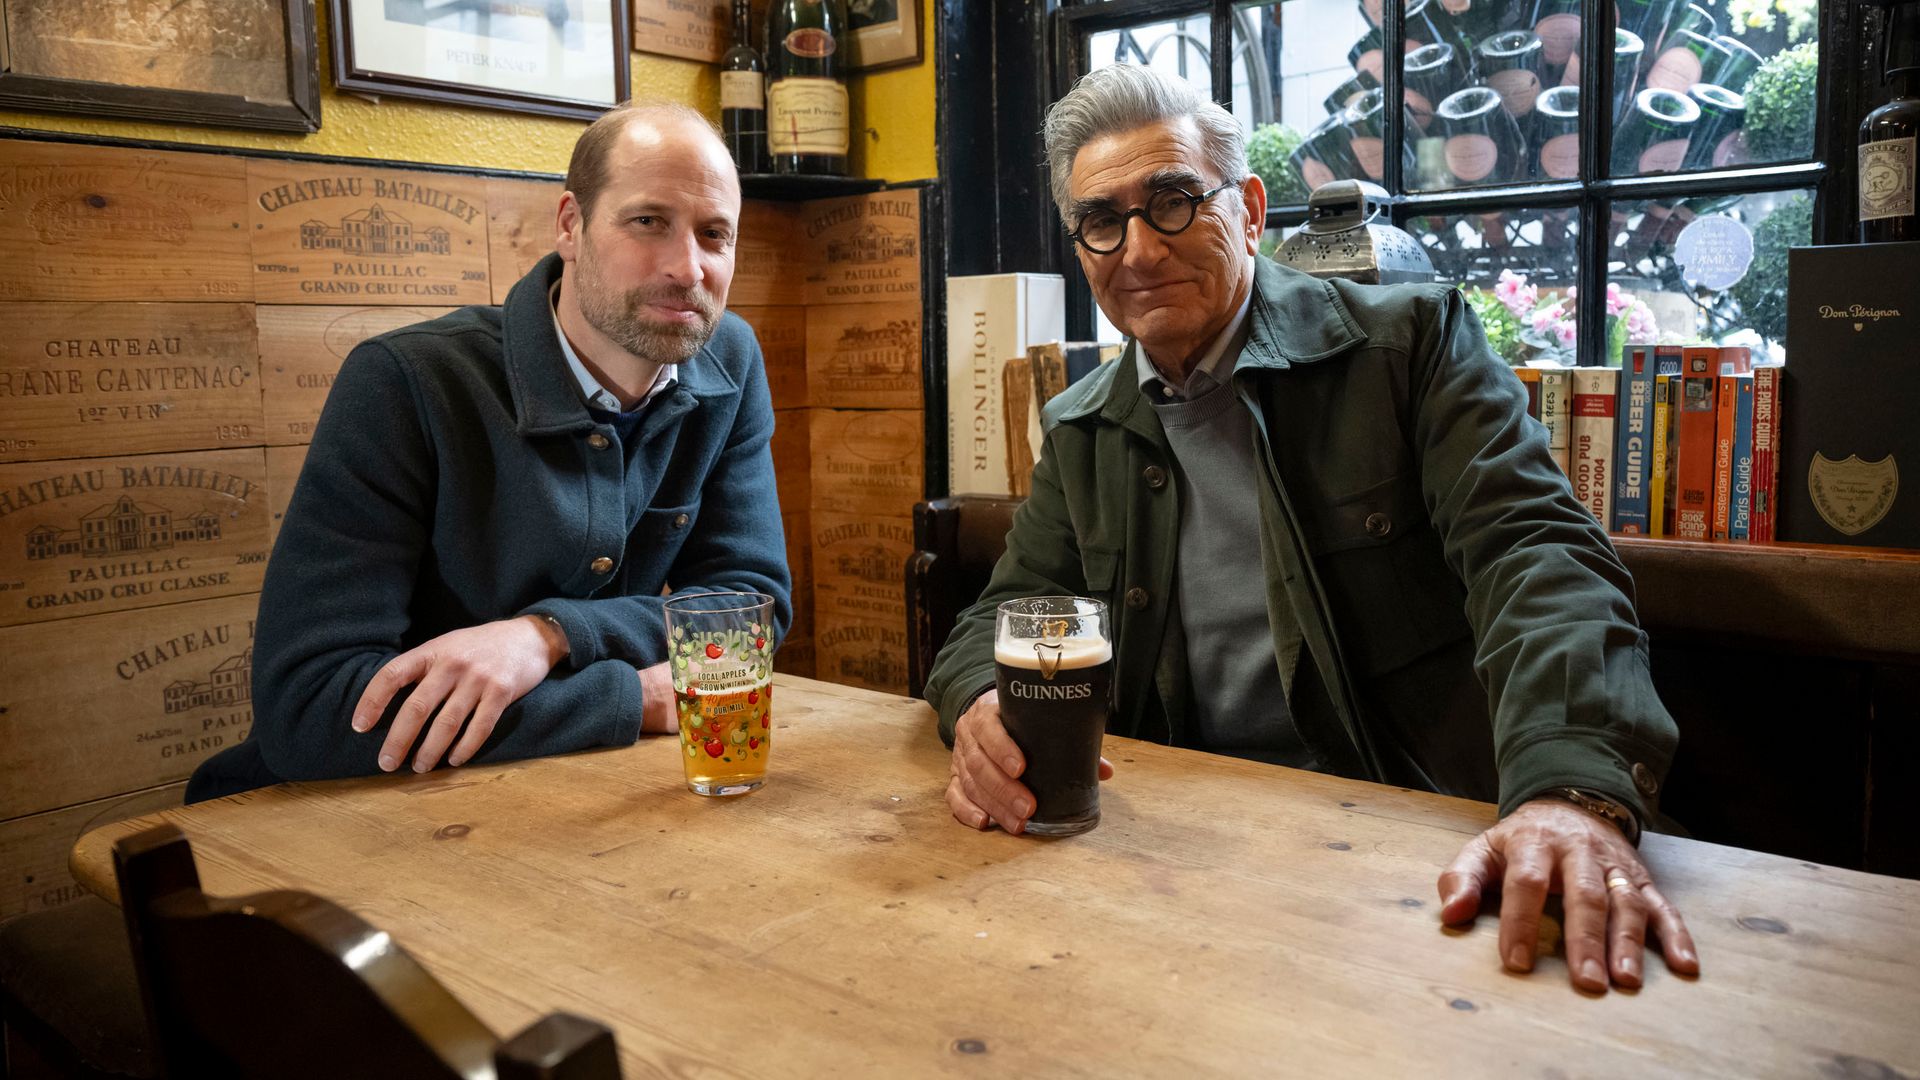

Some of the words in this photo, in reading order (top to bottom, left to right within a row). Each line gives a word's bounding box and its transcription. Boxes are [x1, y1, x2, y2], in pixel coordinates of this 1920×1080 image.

[446, 48, 490, 67] PETER
[258, 177, 362, 214] CHATEAU
[374, 178, 481, 225] BATAILLEY
[806, 203, 863, 239] CHATEAU
[332, 262, 427, 277] PAUILLAC
[1691, 255, 1737, 265] FAMILY
[462, 270, 486, 281] 2000
[845, 268, 901, 281] PAUILLAC
[301, 280, 360, 294] GRAND
[365, 282, 398, 295] CRU
[403, 283, 458, 296] CLASSE
[827, 286, 860, 296] GRAND
[863, 284, 883, 295] CRU
[1819, 305, 1848, 319] Dom
[1849, 304, 1901, 321] Pérignon
[45, 337, 181, 358] CHATEAU
[97, 365, 246, 392] CANTENAC
[1659, 361, 1678, 374] GOOD
[1757, 368, 1772, 390] THE
[973, 311, 988, 472] BOLLINGER
[989, 346, 997, 436] CHAMPAGNE
[117, 404, 163, 420] VIN
[1545, 391, 1555, 418] REES
[1629, 379, 1645, 433] BEER
[1757, 390, 1771, 421] PARIS
[1655, 406, 1667, 450] Barcelona
[1756, 422, 1771, 452] GUIDE
[1579, 434, 1591, 461] PUB
[1718, 438, 1729, 469] Guide
[1593, 458, 1605, 490] 2004
[1626, 437, 1643, 499] GUIDE
[1654, 453, 1665, 479] Guide
[1735, 456, 1750, 493] Guide
[116, 466, 259, 502] BATAILLEY
[1577, 463, 1591, 507] GOOD
[1715, 473, 1728, 528] Amsterdam
[1734, 494, 1749, 529] Paris
[817, 522, 873, 548] CHATEAU
[1678, 521, 1707, 531] GUIDE
[69, 557, 191, 583] PAUILLAC
[236, 553, 266, 565] 2000
[27, 587, 104, 610] GRAND
[111, 582, 153, 599] CRU
[160, 572, 231, 593] CLASSE
[837, 597, 870, 611] GRAND
[820, 626, 876, 649] CHATEAU
[115, 624, 230, 681] CHATEAU
[698, 672, 719, 681] LOCAL
[721, 668, 747, 680] APPLES
[699, 681, 725, 691] GROWN
[726, 680, 746, 688] WITHIN
[1010, 680, 1092, 700] GUINNESS
[713, 705, 727, 715] OUR
[729, 703, 745, 712] MILL
[161, 735, 224, 759] GRAND
